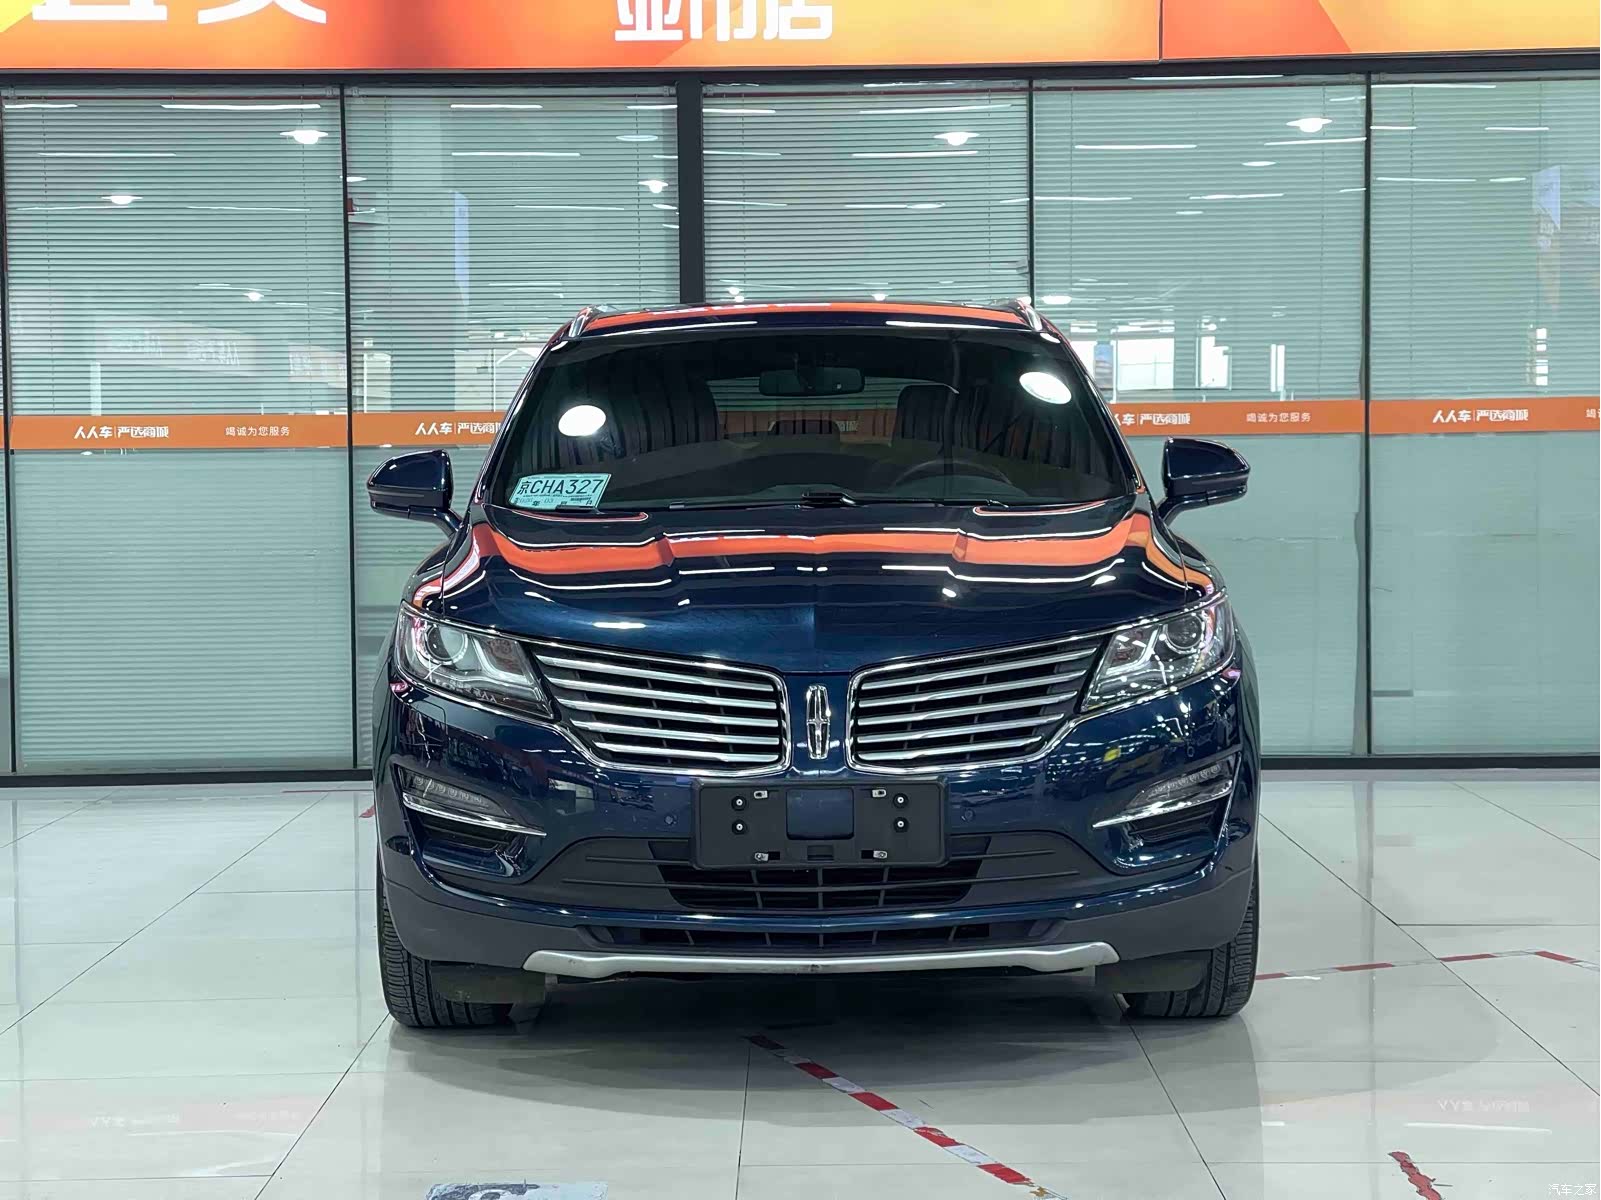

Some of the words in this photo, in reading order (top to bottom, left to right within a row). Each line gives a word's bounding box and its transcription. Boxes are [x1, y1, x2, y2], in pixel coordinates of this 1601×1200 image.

[1432, 409, 1472, 423] 人人车
[73, 425, 113, 439] 人人车
[225, 425, 290, 437] 竭诚为您服务
[414, 422, 453, 436] 人人车
[517, 479, 605, 495] 京CHA327
